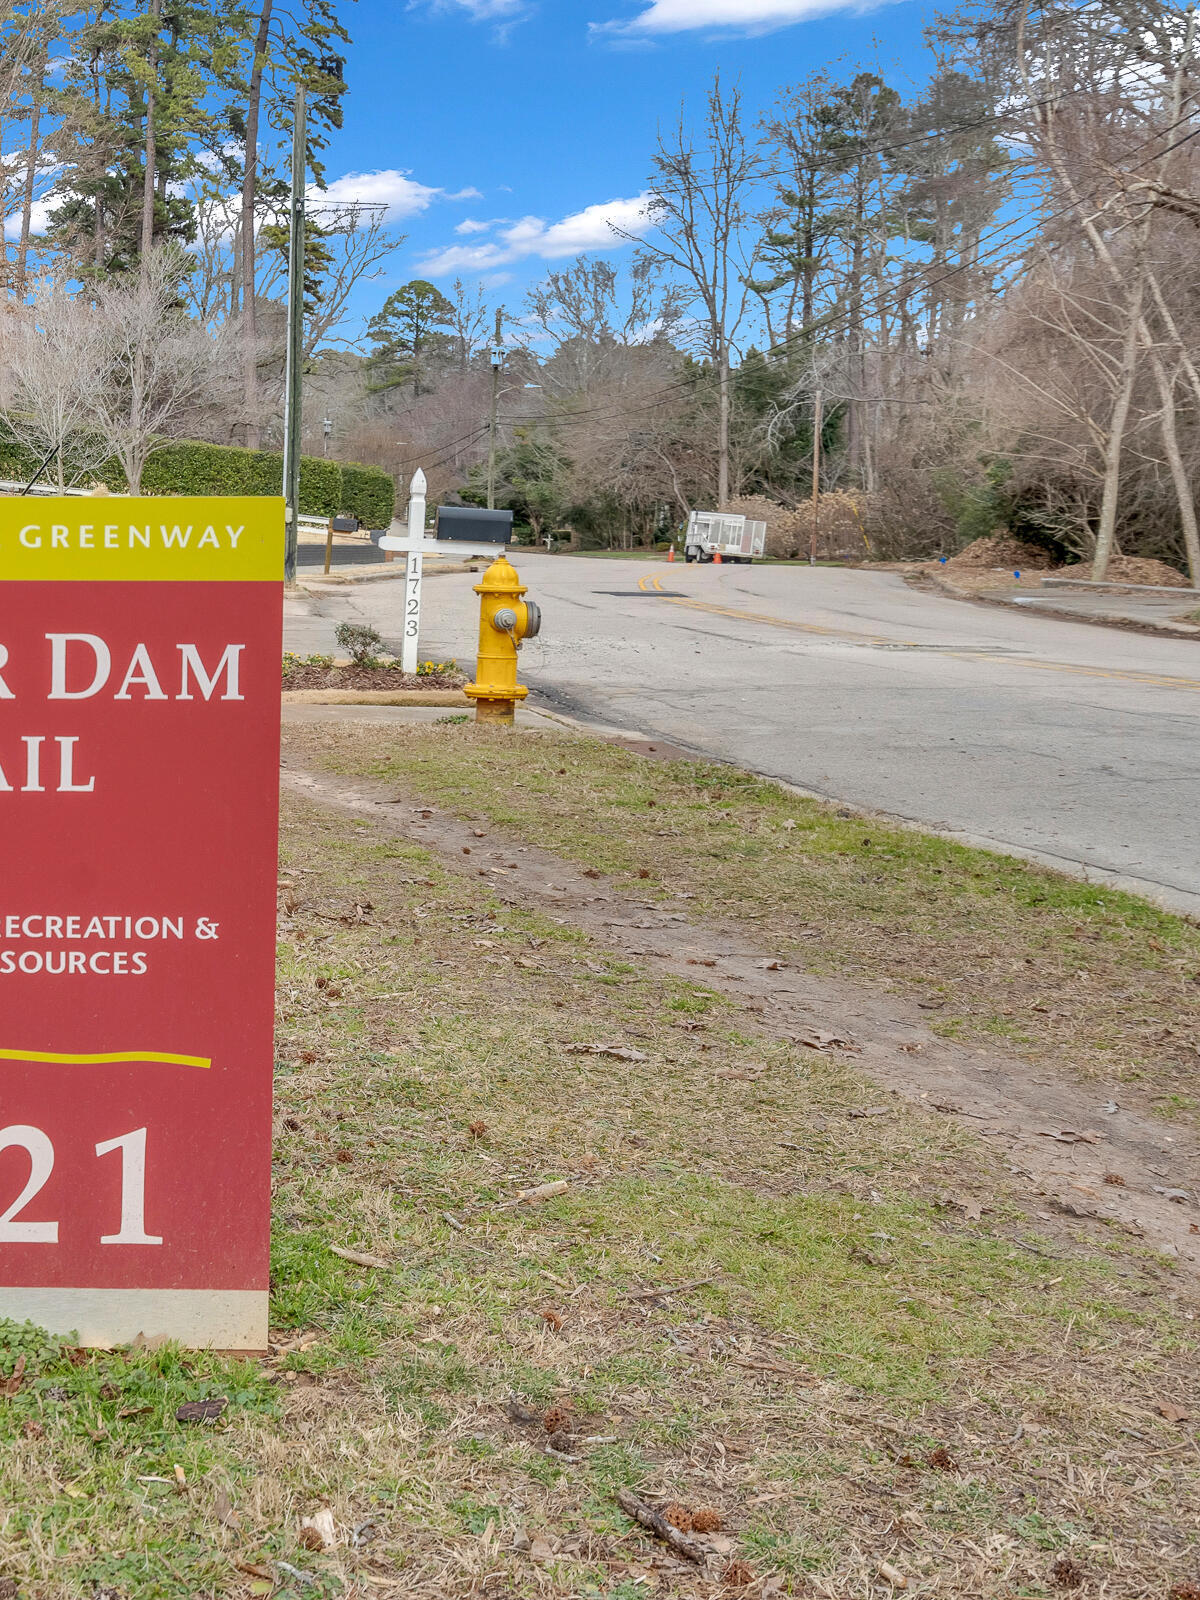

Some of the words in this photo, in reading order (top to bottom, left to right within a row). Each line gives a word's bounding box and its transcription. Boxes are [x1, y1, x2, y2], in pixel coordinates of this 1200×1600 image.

[18, 524, 247, 550] GREENWAY
[405, 556, 421, 637] 1723
[44, 632, 246, 701] DAM
[193, 916, 220, 940] &
